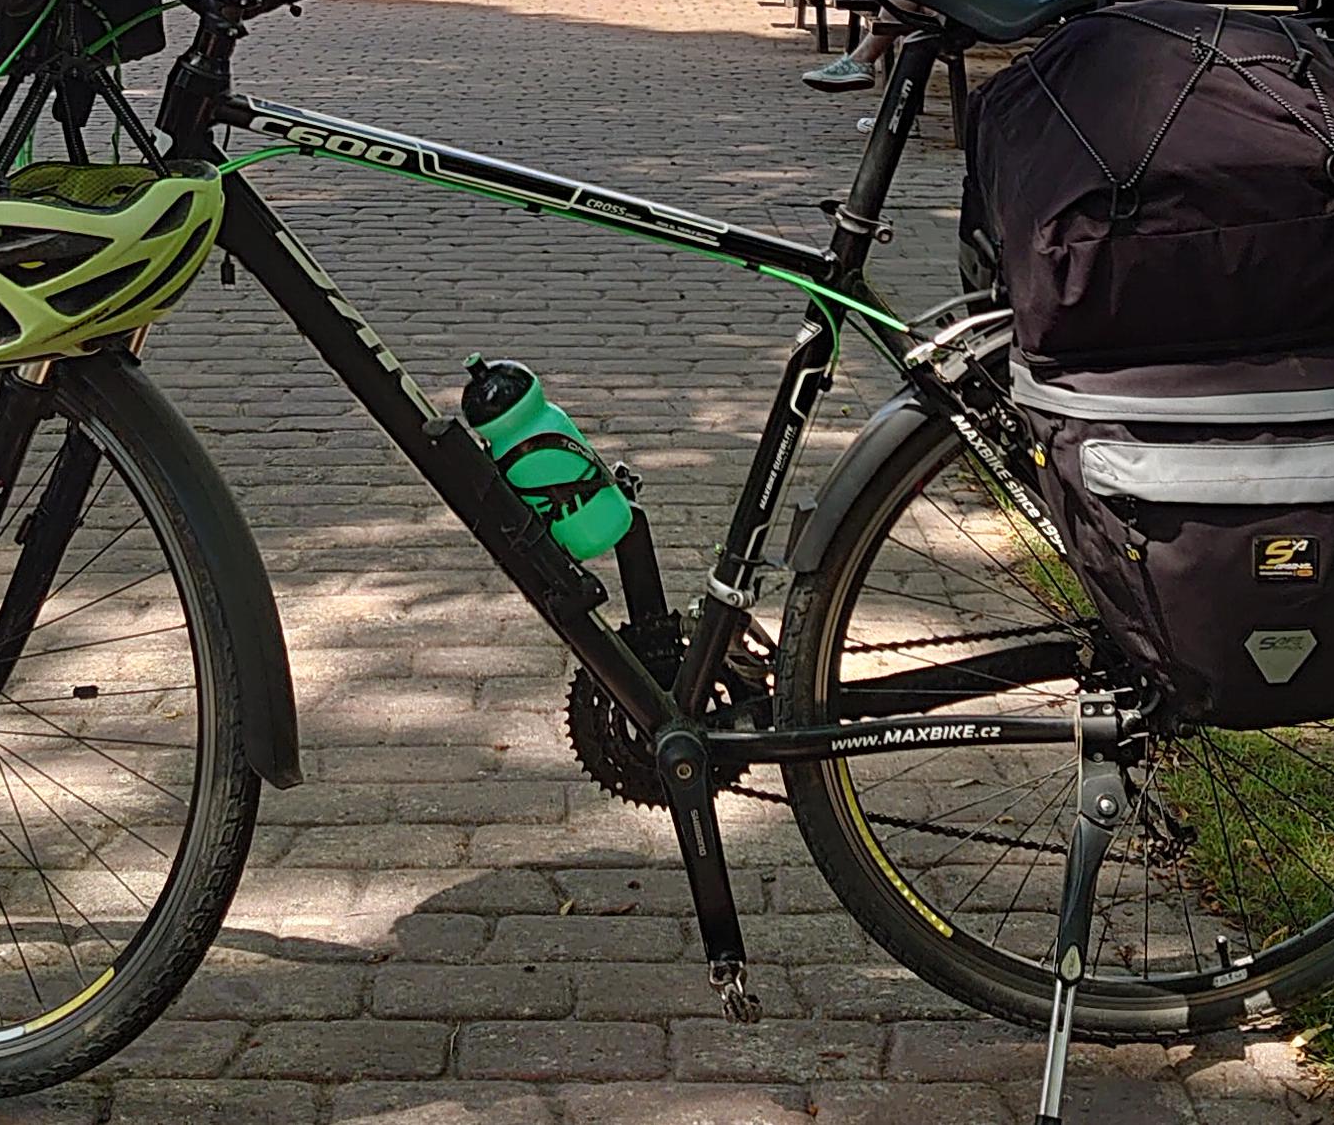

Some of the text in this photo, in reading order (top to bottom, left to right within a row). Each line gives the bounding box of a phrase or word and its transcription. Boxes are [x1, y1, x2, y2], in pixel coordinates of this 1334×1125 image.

[249, 116, 407, 167] C600
[586, 198, 627, 217] CROSS
[950, 414, 1013, 480] MAXBIKE
[1006, 480, 1041, 519] since
[831, 725, 1002, 752] www.MAXBIKE.cz
